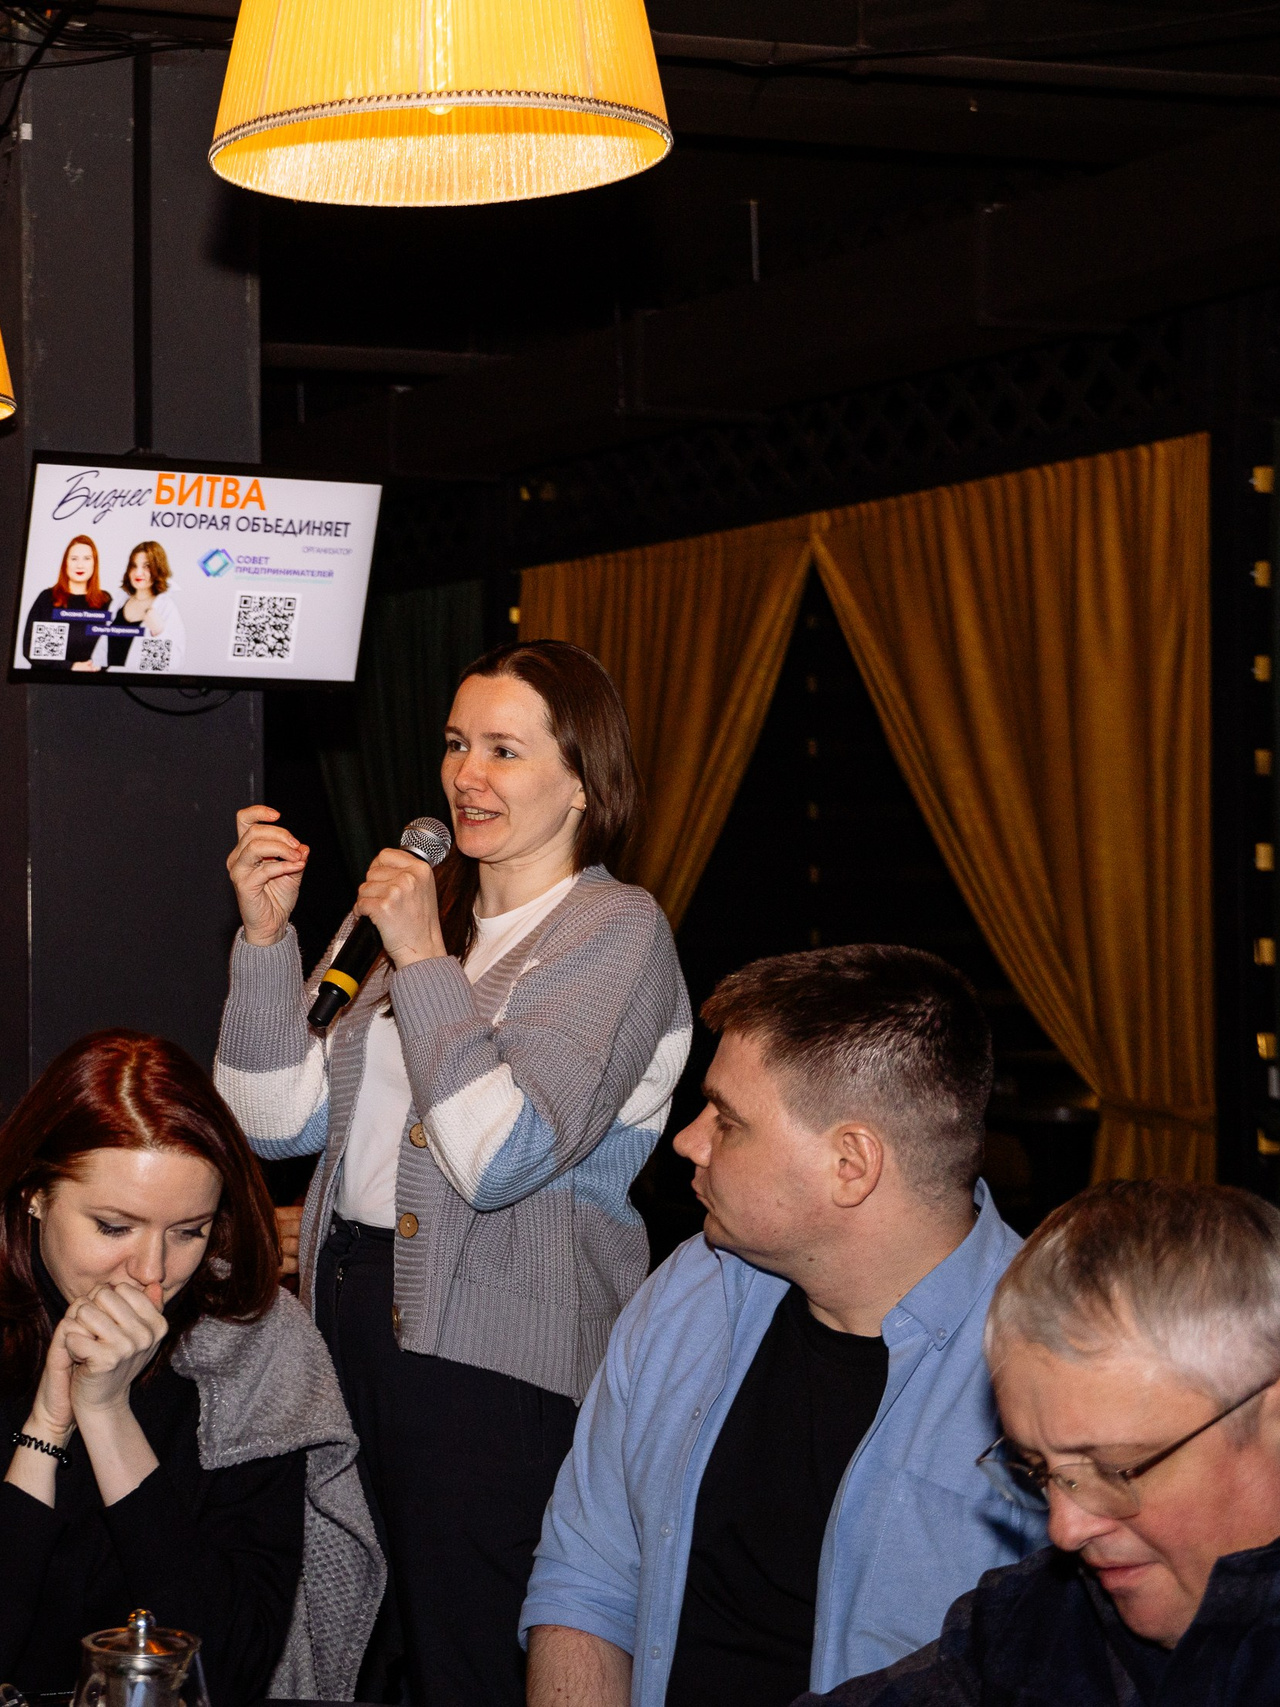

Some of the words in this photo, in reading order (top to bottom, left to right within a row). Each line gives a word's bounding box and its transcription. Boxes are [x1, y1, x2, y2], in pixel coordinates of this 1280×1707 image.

[52, 470, 153, 524] Бизнес
[155, 472, 267, 511] БИТВА
[150, 511, 231, 531] КОТОРАЯ
[236, 516, 351, 538] ОБЪЕДИНЯЕТ
[236, 555, 269, 566] СОВЕТ
[235, 566, 335, 578] ПРЕДПРИНИМАТЕЛЕЙ
